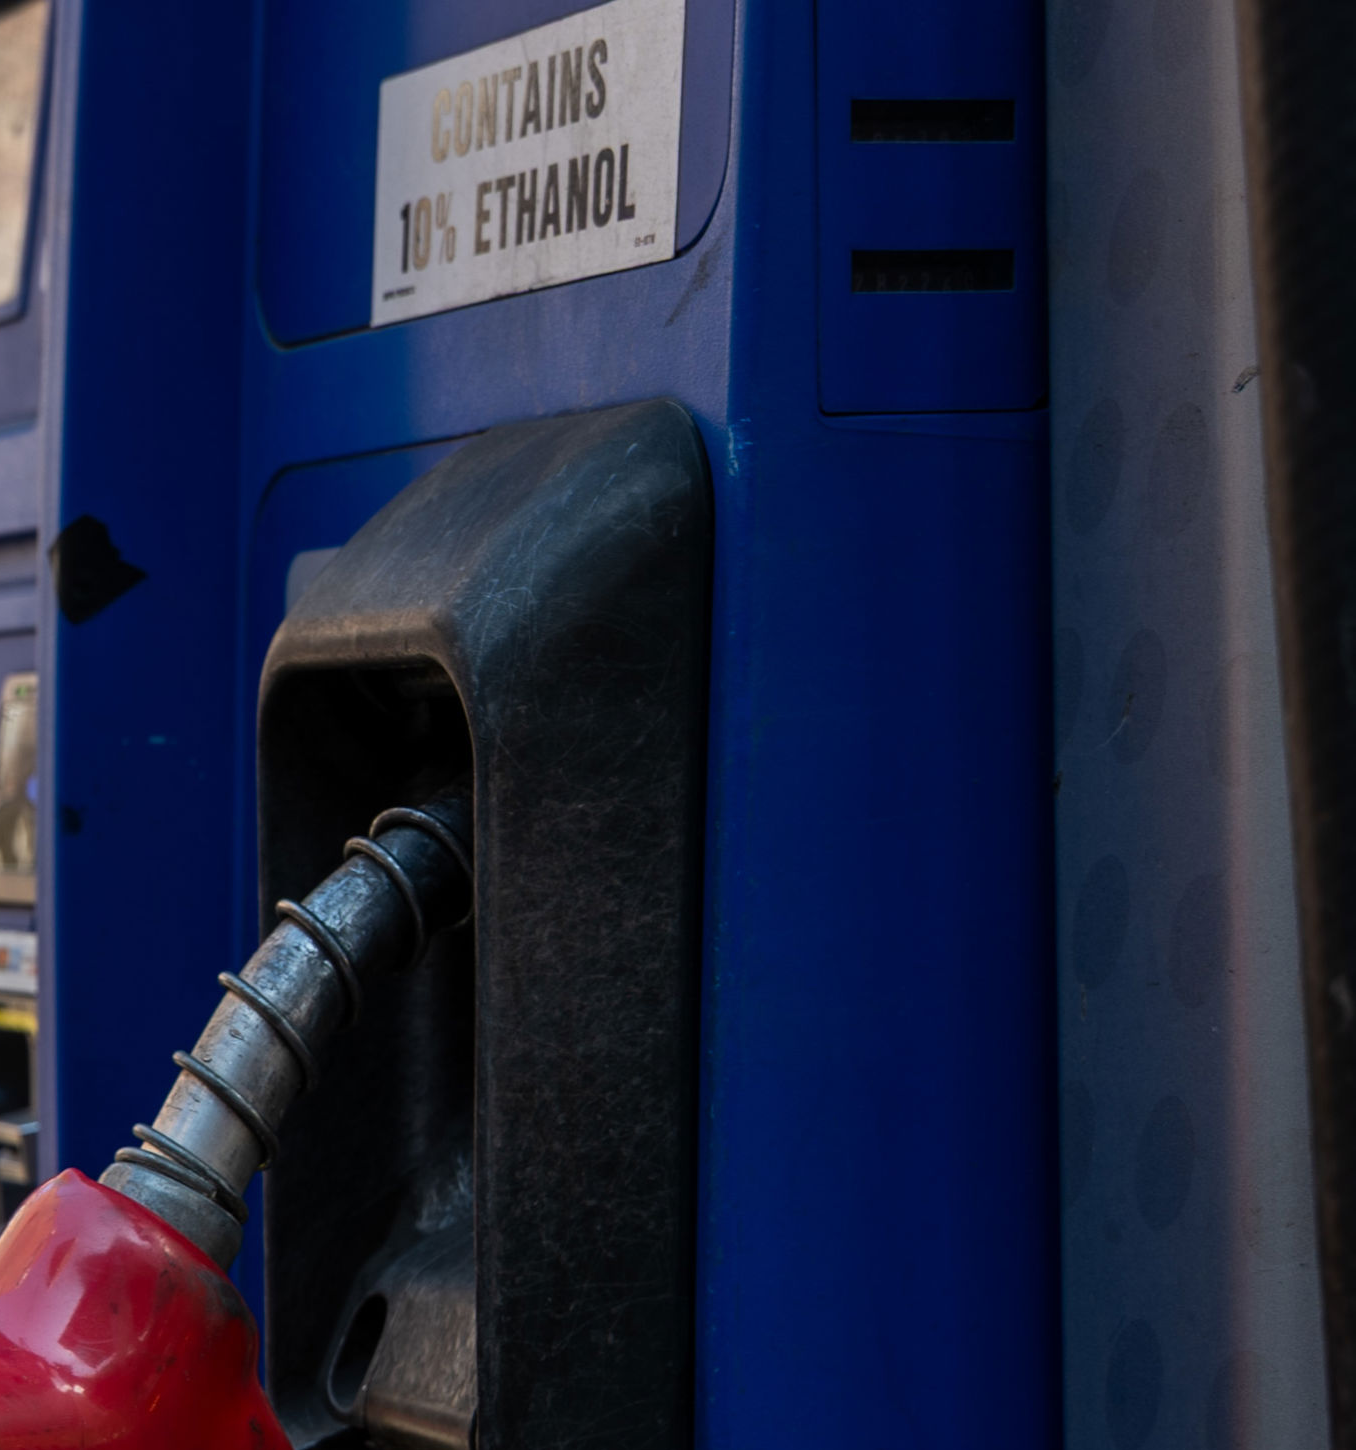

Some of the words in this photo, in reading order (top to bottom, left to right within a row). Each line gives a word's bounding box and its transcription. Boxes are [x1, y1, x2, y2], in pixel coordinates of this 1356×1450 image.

[429, 38, 608, 164] CONTAINS
[400, 190, 457, 274] 10%
[473, 143, 636, 256] ETHANOL
